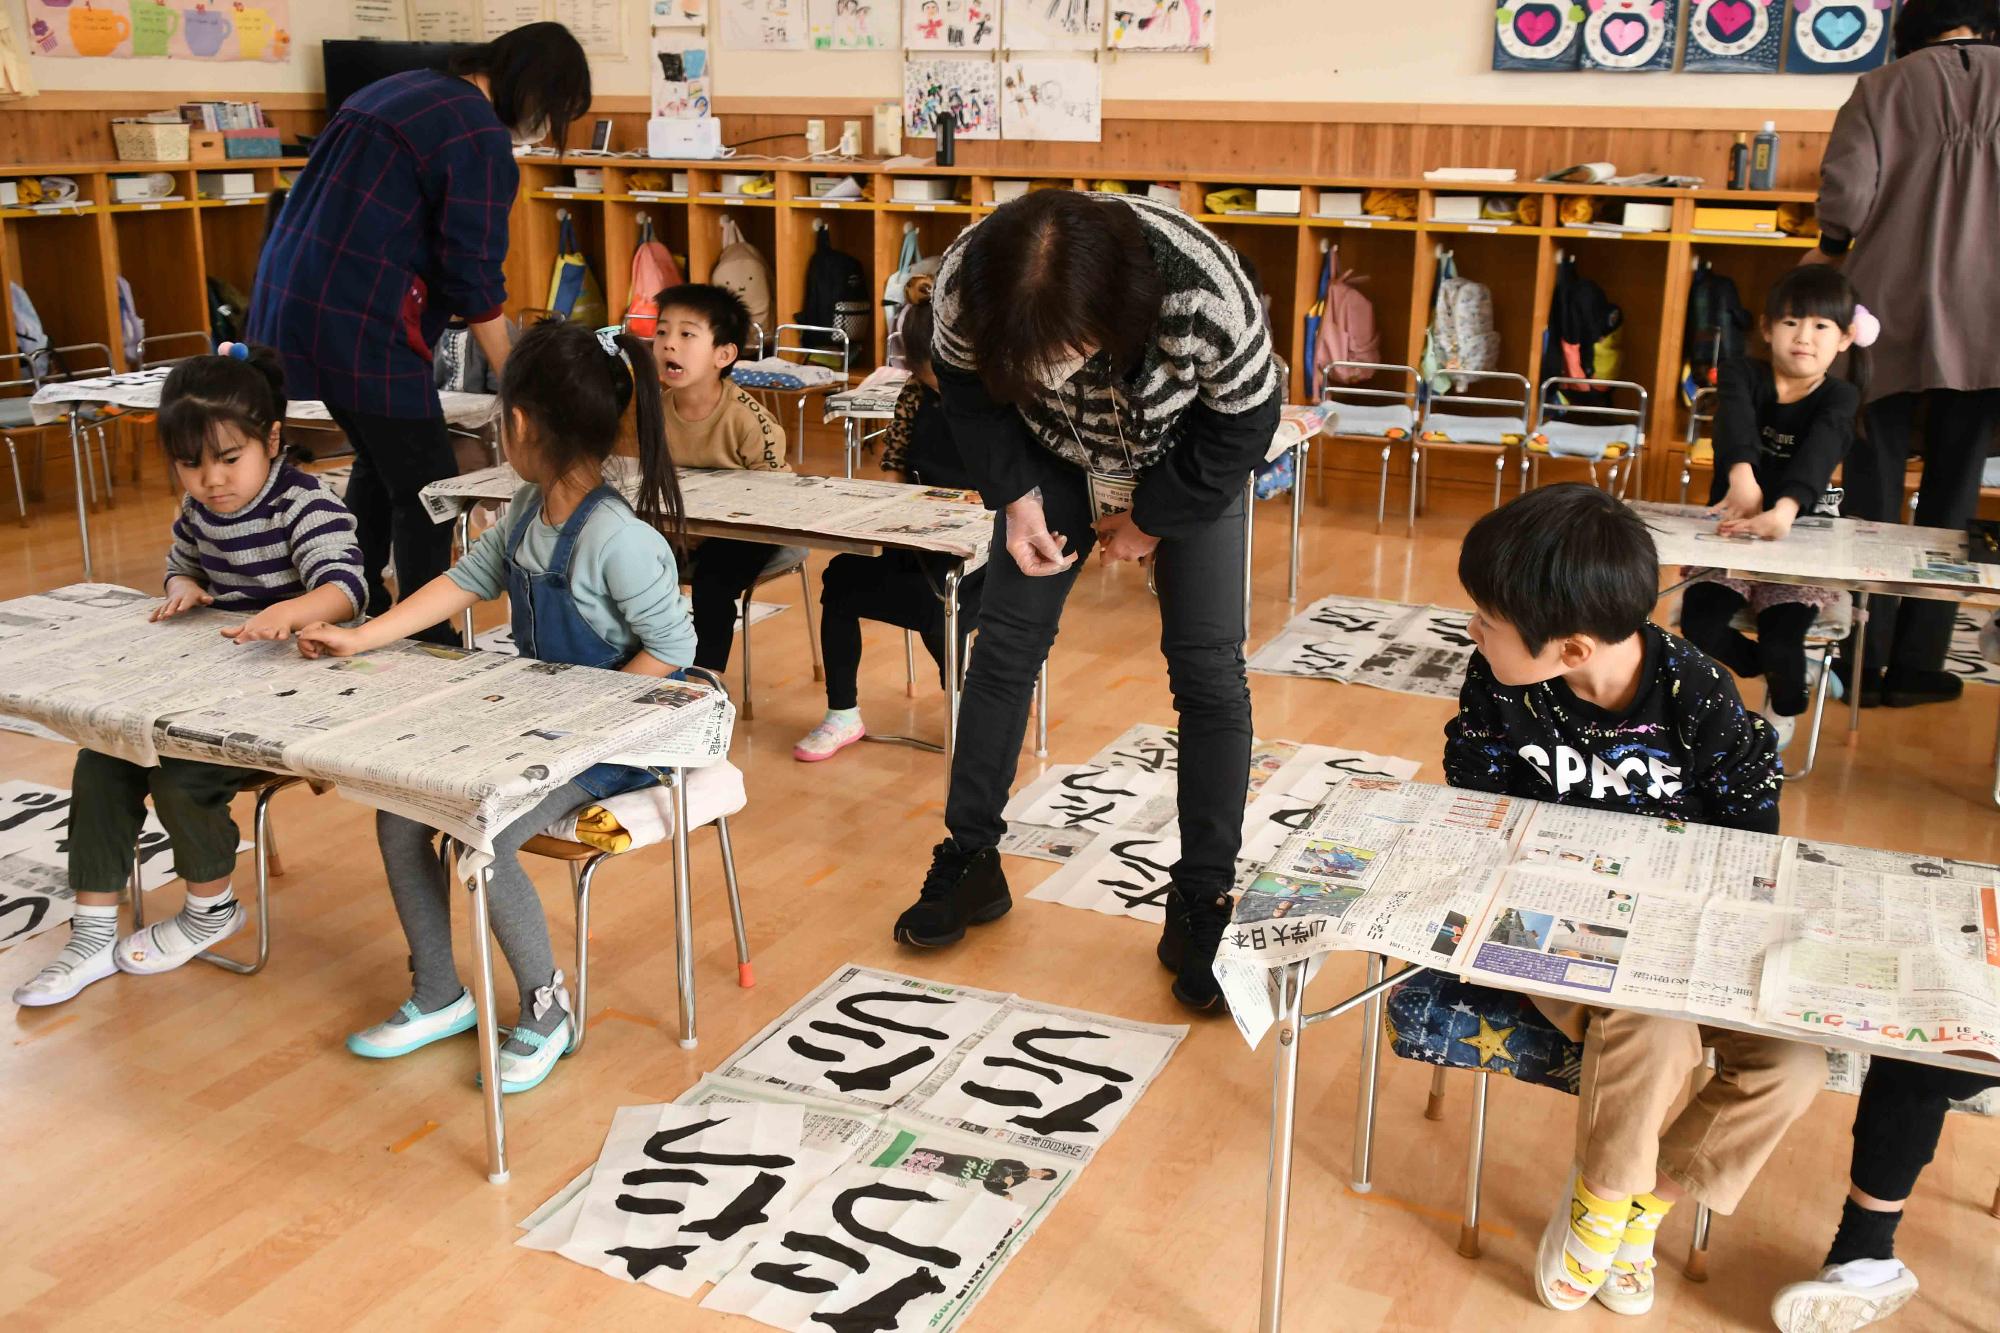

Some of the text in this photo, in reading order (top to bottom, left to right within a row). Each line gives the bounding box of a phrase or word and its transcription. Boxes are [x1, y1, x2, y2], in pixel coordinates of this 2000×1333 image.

[1518, 744, 1683, 800] SPACE
[787, 990, 956, 1094] たつ
[960, 1025, 1135, 1136] たつ
